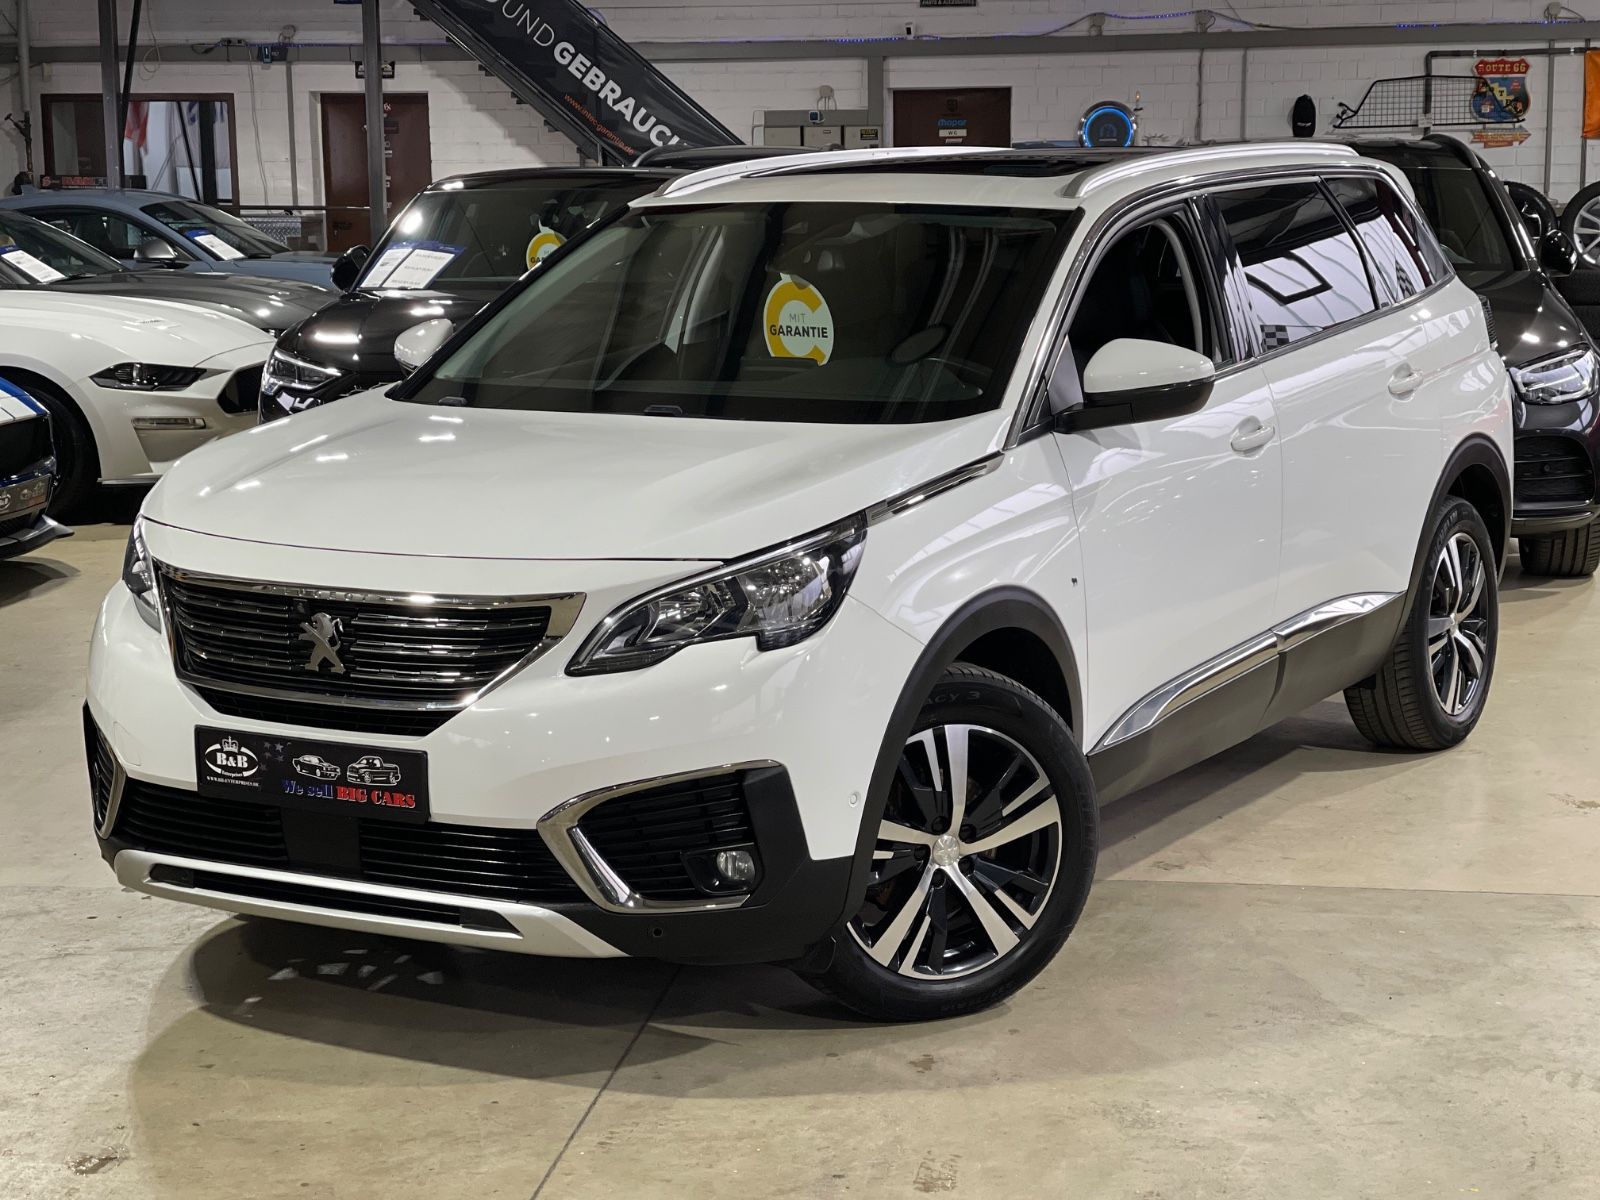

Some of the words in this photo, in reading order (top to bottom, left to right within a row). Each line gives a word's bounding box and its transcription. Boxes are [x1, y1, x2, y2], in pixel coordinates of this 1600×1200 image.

[1513, 63, 1526, 73] 66
[789, 313, 806, 324] MIT
[769, 324, 828, 338] GARANTIE
[215, 752, 249, 769] B&B
[282, 779, 304, 795] We
[307, 784, 334, 799] sell
[336, 785, 368, 803] BIG
[371, 790, 416, 809] CARS
